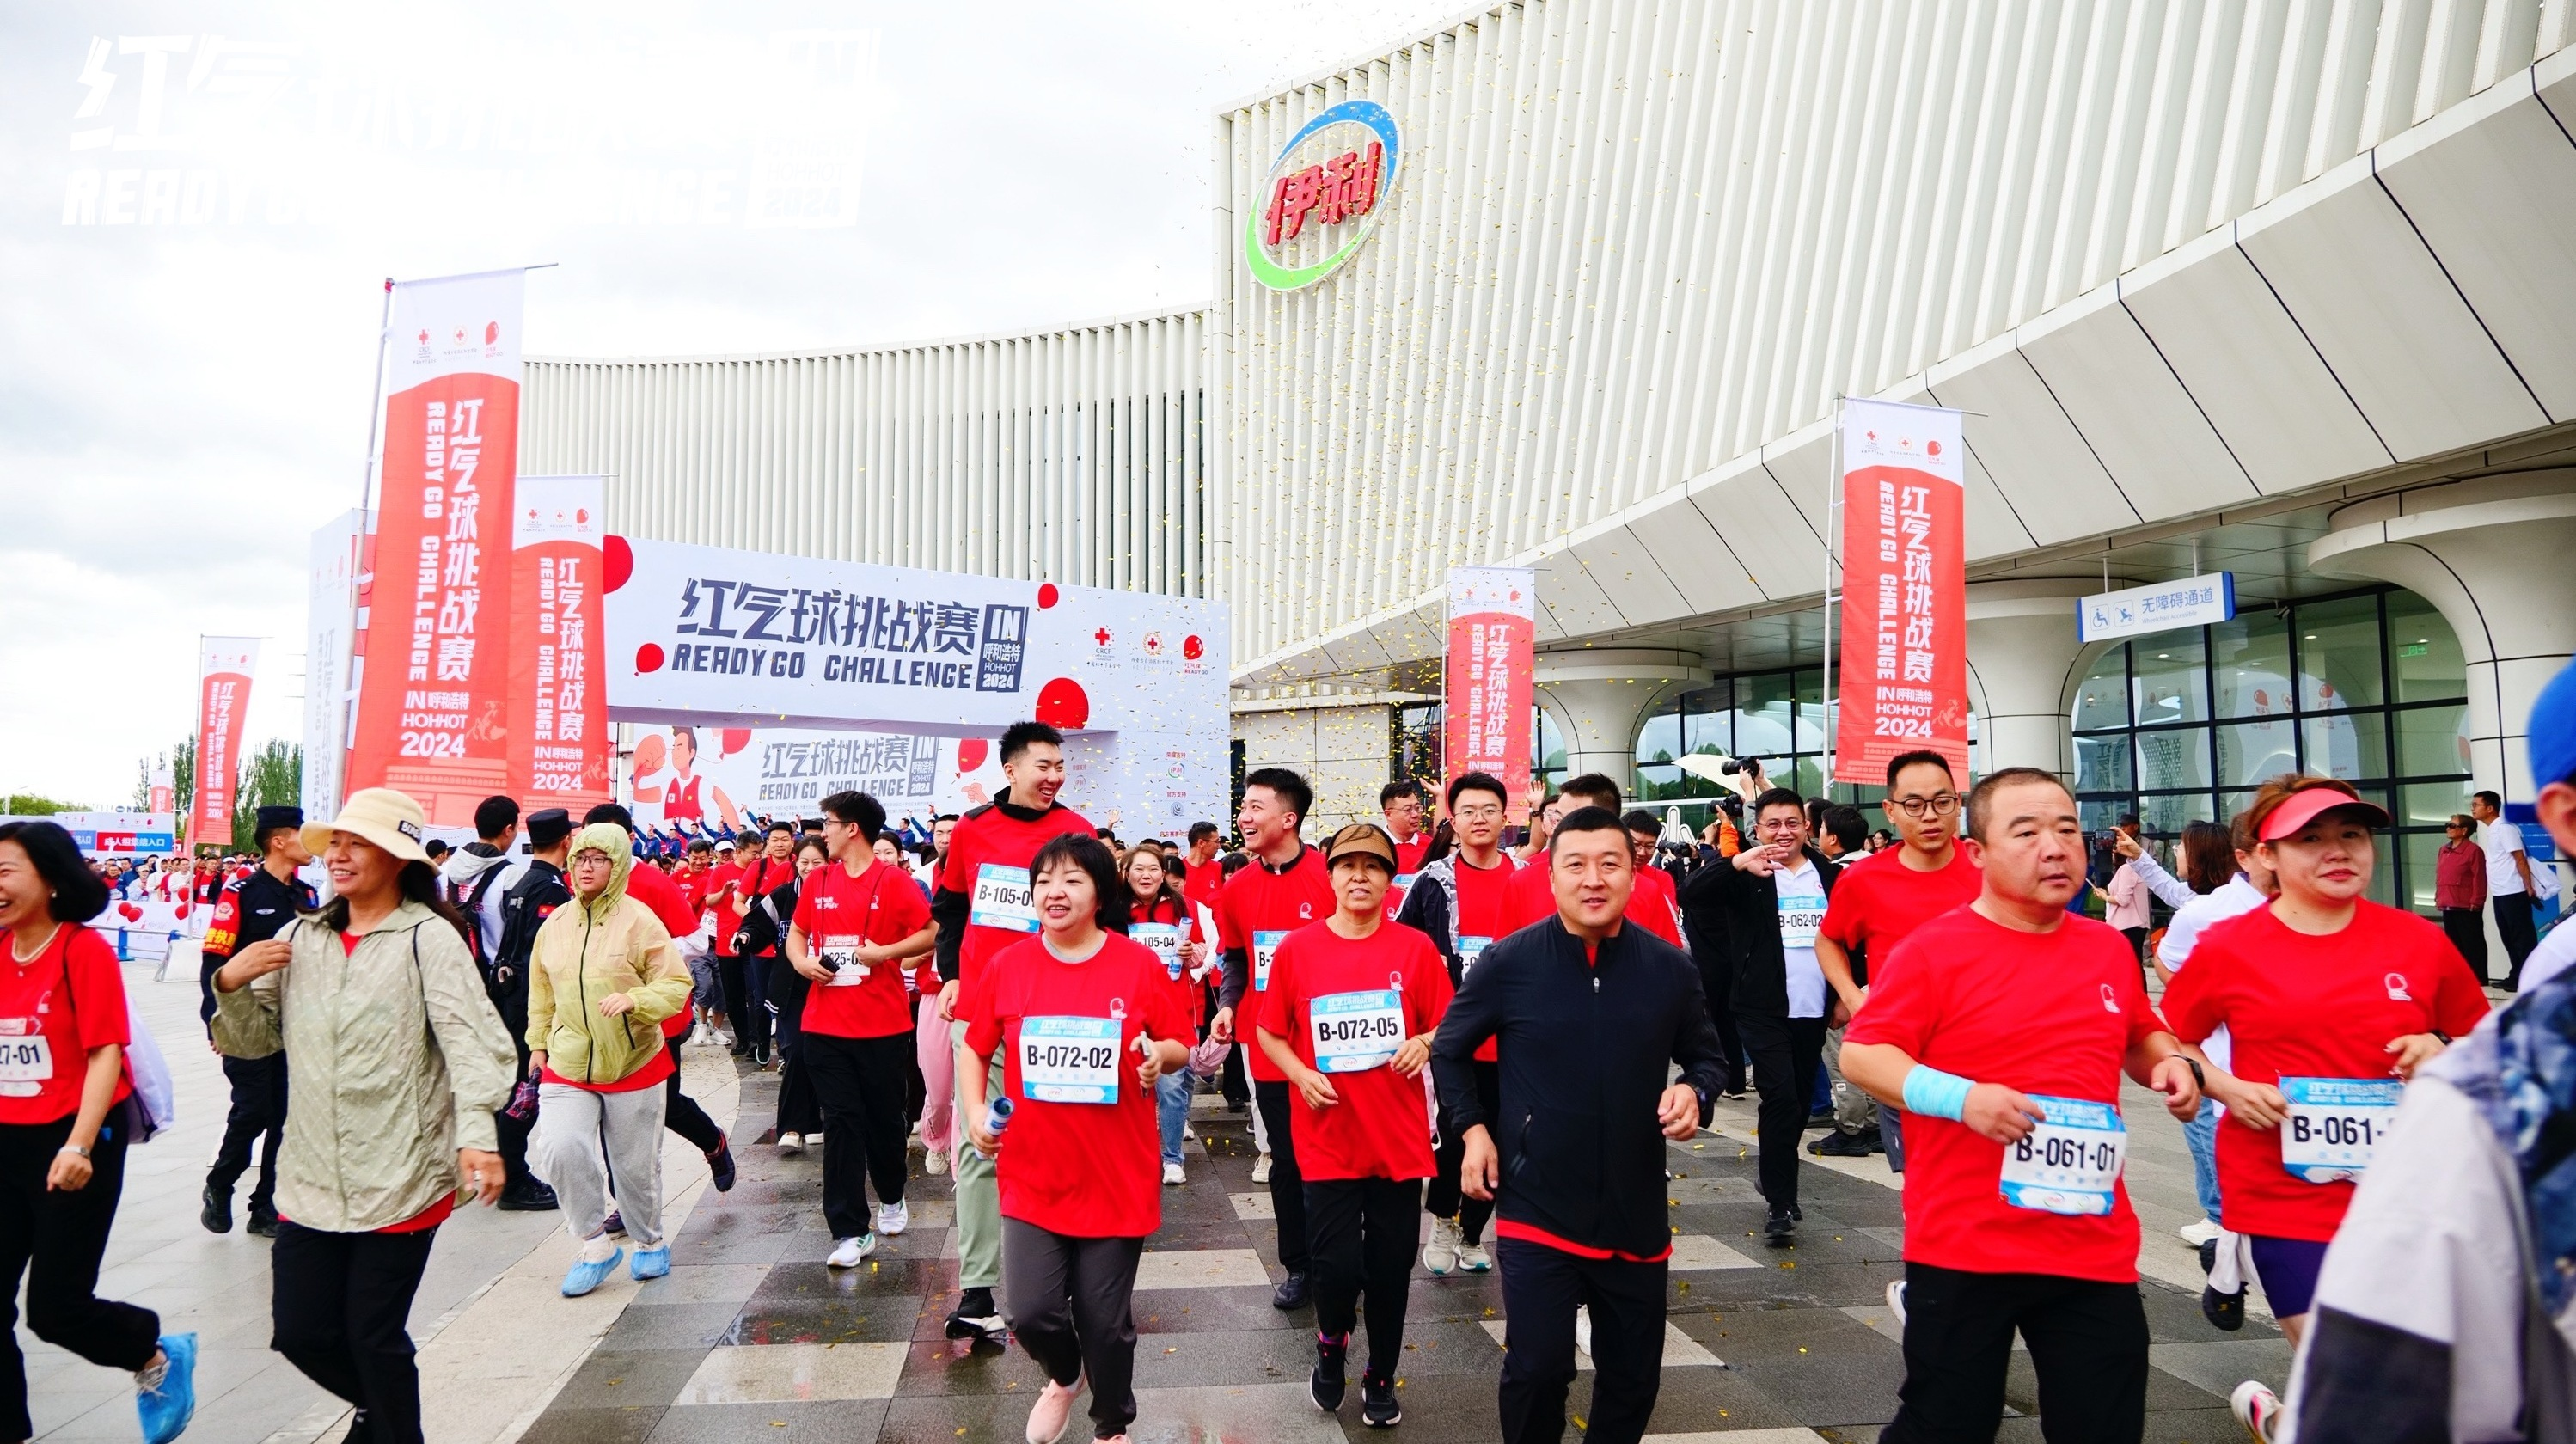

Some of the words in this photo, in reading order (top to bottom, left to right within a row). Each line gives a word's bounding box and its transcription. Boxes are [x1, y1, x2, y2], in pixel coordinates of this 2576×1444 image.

[1265, 140, 1382, 246] 伊利
[426, 401, 446, 481] READY
[423, 486, 444, 519] GO
[1879, 480, 1897, 538] READY
[437, 398, 484, 682] 红气球挑战赛
[1880, 539, 1898, 563] GO
[539, 557, 554, 608] READY
[1900, 486, 1935, 683] 红气球挑战赛
[408, 536, 440, 682] CHALLENGE
[2142, 586, 2214, 615] 无障碍通道
[539, 609, 554, 634] GO
[676, 578, 979, 656] 红气球挑战赛
[990, 609, 1021, 641] IN
[1877, 573, 1899, 681] CHALLENGE
[2143, 615, 2170, 625] Wheelchair
[2170, 610, 2198, 621] Accessible
[558, 558, 586, 740] 红气球挑战赛
[982, 643, 1021, 662] 呼和浩特
[1471, 624, 1484, 662] READY
[671, 643, 767, 676] READY
[770, 651, 805, 679] GO
[823, 655, 973, 688] CHALLENGE
[984, 663, 1016, 673] HOHHOT
[535, 645, 553, 740] CHALLENGE
[982, 673, 1014, 688] 2024
[1485, 624, 1510, 757] 红气球挑战赛
[1876, 686, 1895, 701] IN
[1896, 688, 1933, 704] 呼和浩特
[405, 691, 425, 710] IN
[427, 692, 470, 711] 呼和浩特
[1875, 703, 1933, 717] HOHHOT
[402, 712, 468, 728] HOHHOT
[1468, 688, 1483, 757] CHALLENGE
[1875, 718, 1933, 738] 2024
[401, 731, 467, 757] 2024
[534, 746, 551, 759] IN
[761, 735, 910, 780] 红气球挑战赛
[534, 761, 583, 773] HOHHOT
[533, 774, 584, 790] 2024
[759, 782, 799, 801] READY
[801, 781, 817, 800] GO
[911, 782, 931, 793] 2024
[979, 884, 1034, 907] B-105-0
[1319, 1017, 1398, 1042] B-072-05
[1027, 1045, 1112, 1068] B-072-02
[2293, 1115, 2395, 1146] B-061-
[2017, 1133, 2115, 1172] B-061-01
